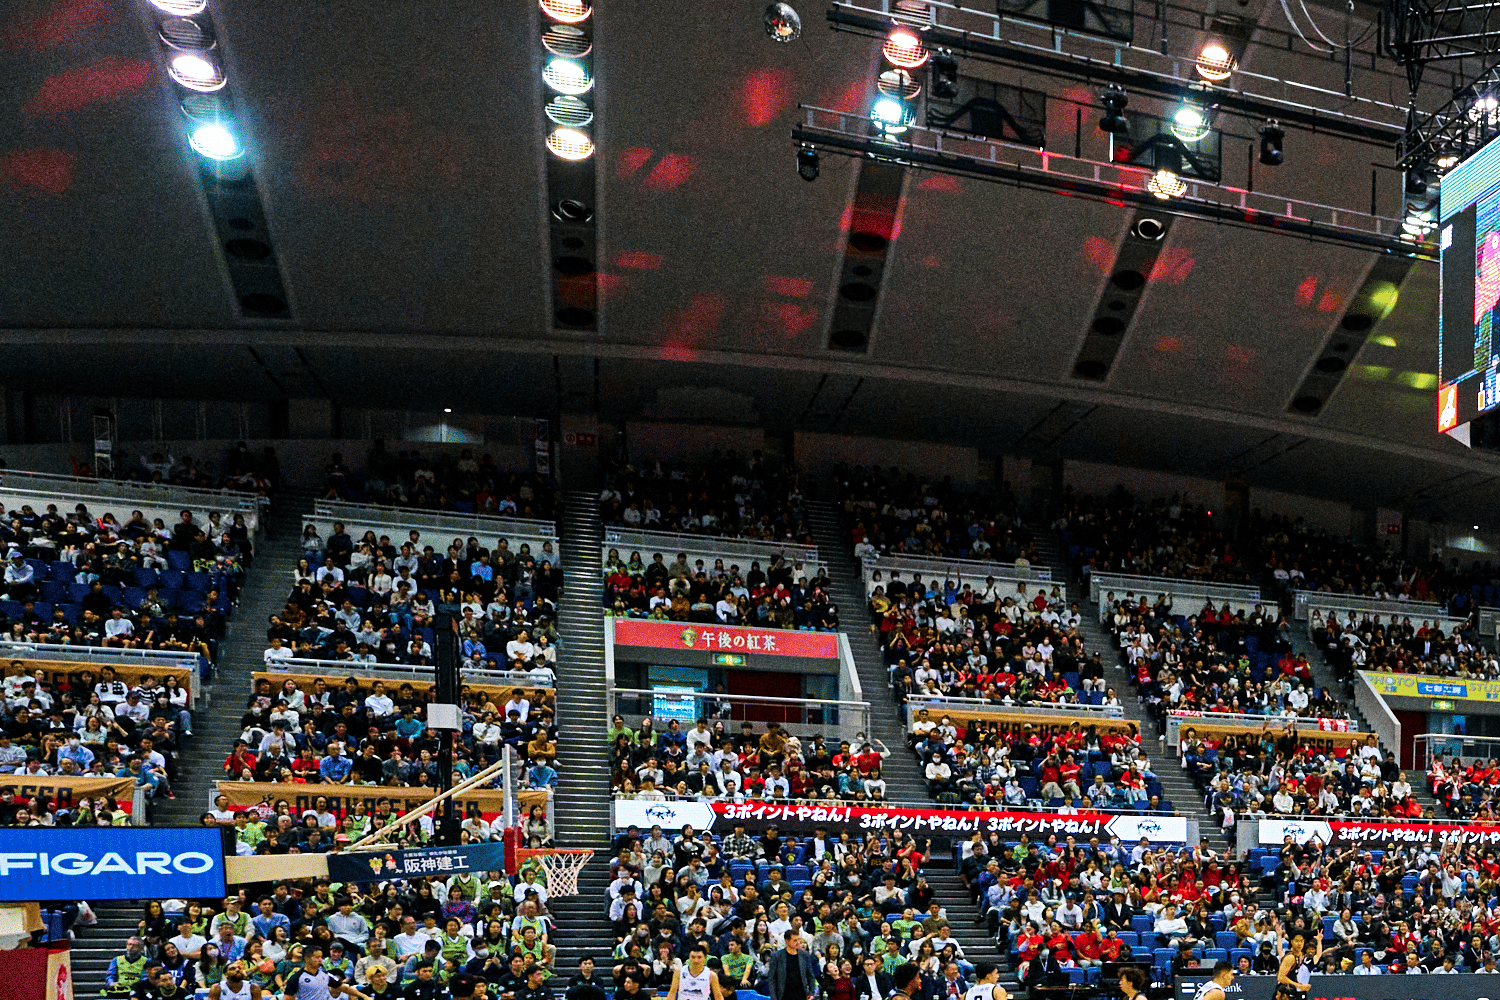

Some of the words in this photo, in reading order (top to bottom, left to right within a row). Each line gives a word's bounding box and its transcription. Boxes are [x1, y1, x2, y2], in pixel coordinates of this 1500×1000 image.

[701, 630, 776, 651] 午後の紅茶
[723, 804, 852, 823] 3ポイントやねん!
[859, 813, 980, 831] 3ポイントやねん!
[987, 817, 1101, 834] 3ポイントやねん!
[1338, 826, 1433, 843] 3ポイントやねん!
[0, 852, 214, 876] FIGARO
[404, 855, 469, 873] 阪神建工
